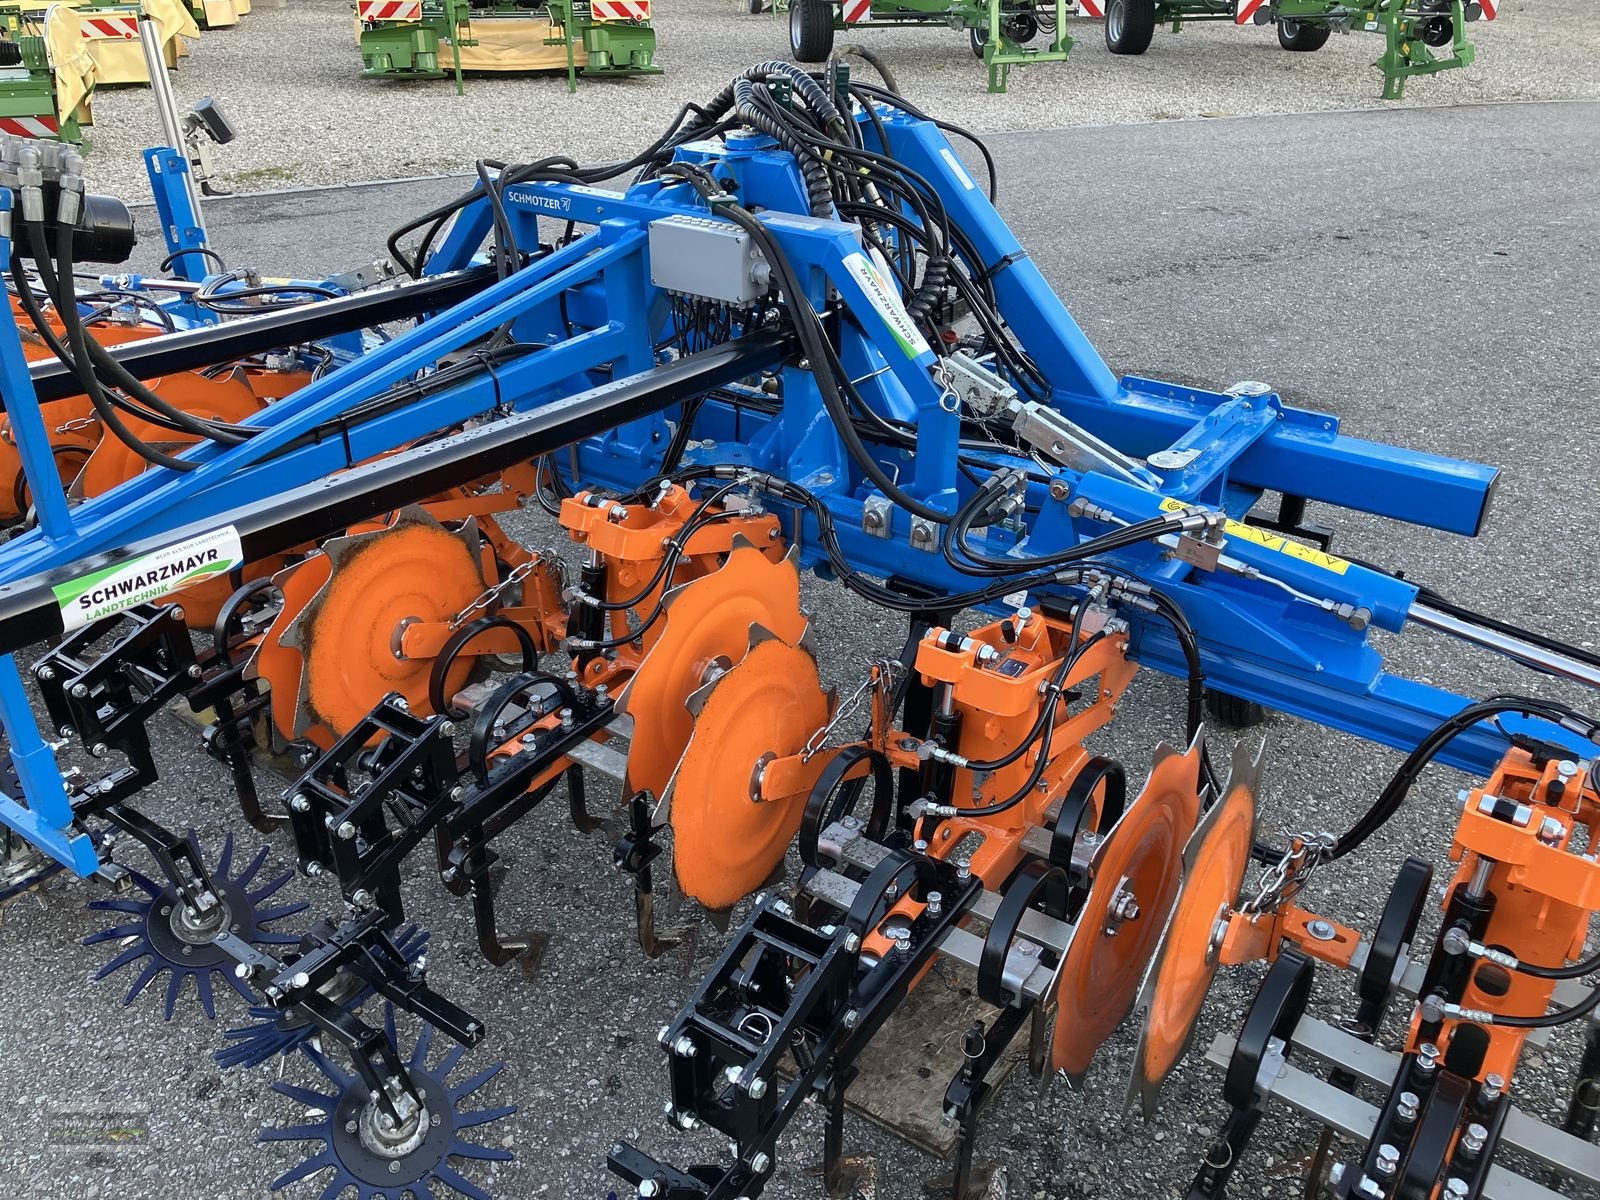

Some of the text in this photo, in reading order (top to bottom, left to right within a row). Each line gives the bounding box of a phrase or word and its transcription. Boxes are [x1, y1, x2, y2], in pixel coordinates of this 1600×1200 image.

[508, 191, 561, 210] SCHMOTZER
[860, 268, 915, 345] SCHWARZMAYR
[79, 548, 218, 610] SCHWARZMAYR
[85, 583, 169, 621] LANDTECHNIK
